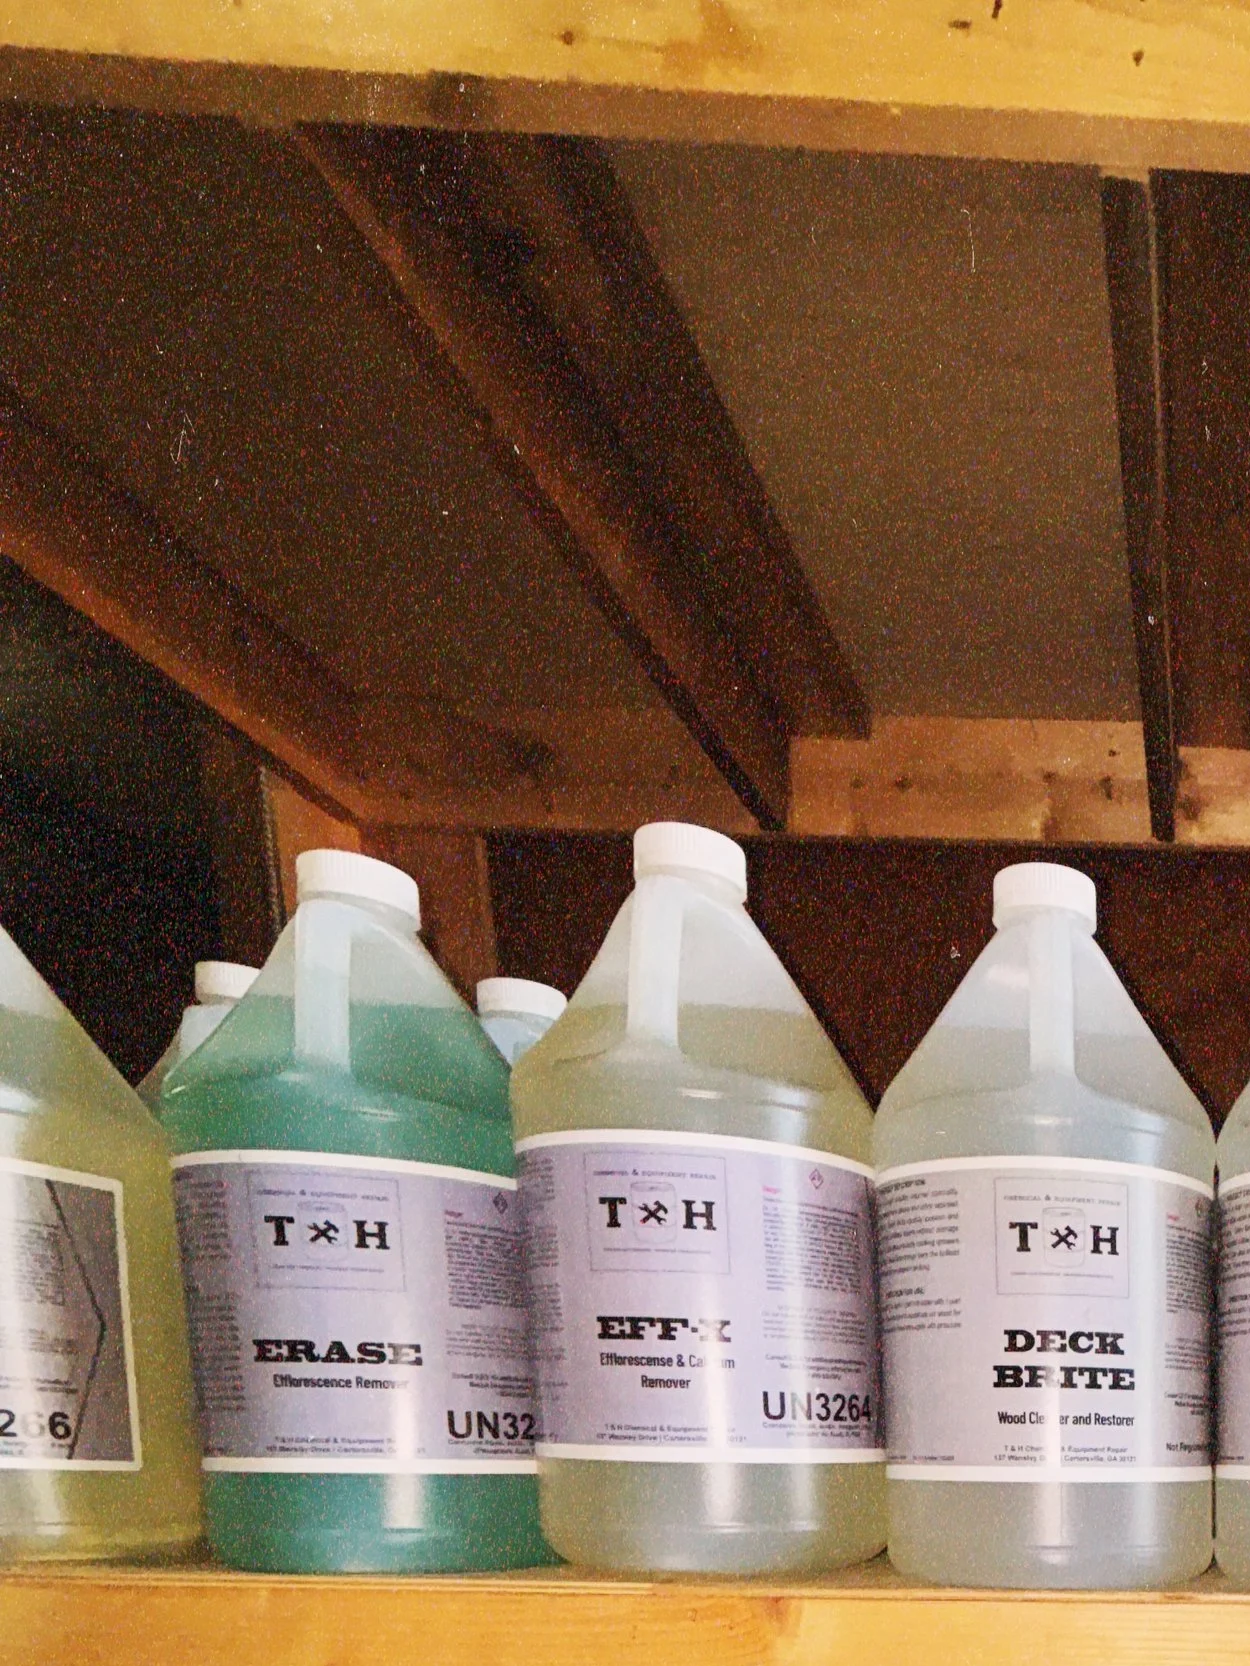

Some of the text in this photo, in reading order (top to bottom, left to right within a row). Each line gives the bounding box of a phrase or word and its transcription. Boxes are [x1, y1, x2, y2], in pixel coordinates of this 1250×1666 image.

[598, 1196, 717, 1231] T H
[264, 1215, 390, 1250] T H
[1008, 1221, 1119, 1256] T H
[596, 1316, 732, 1343] EFF-X
[1003, 1329, 1125, 1356] DECK
[252, 1338, 423, 1366] ERASE
[676, 1353, 685, 1368] &
[641, 1374, 691, 1390] Remover
[993, 1365, 1135, 1391] BRITE
[762, 1391, 872, 1422] UN3264
[997, 1411, 1135, 1427] Wood Cleer and Restorer
